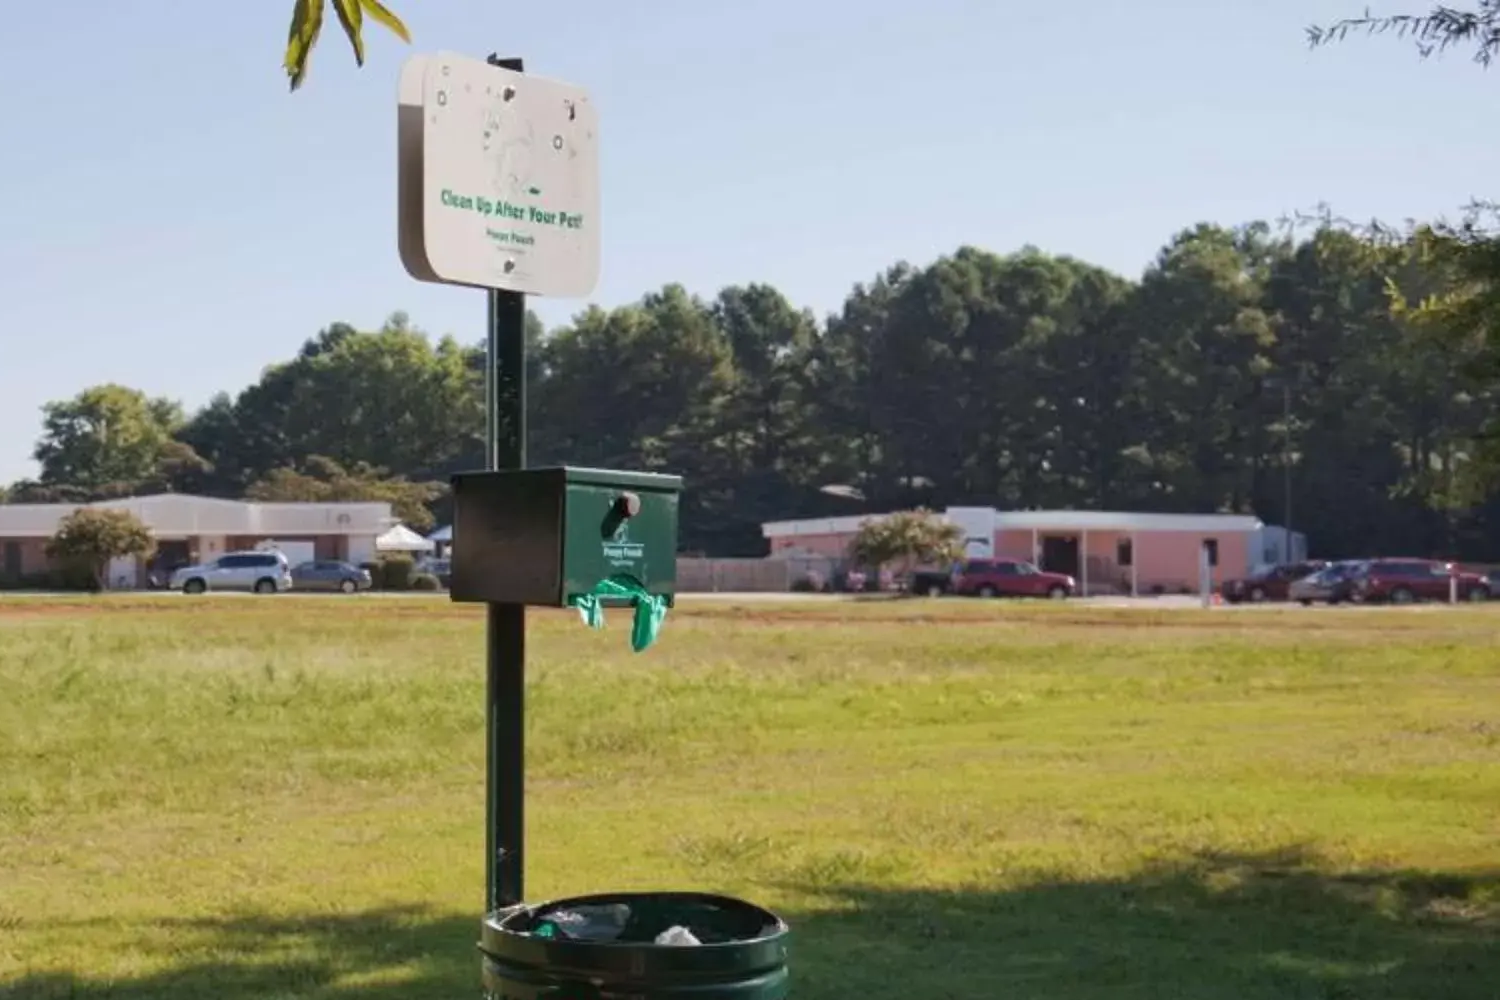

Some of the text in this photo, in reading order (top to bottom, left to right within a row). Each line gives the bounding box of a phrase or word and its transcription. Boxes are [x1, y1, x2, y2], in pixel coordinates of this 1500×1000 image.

[441, 189, 473, 210] Clean
[476, 196, 493, 215] Up
[495, 200, 525, 220] After
[529, 205, 557, 224] Your
